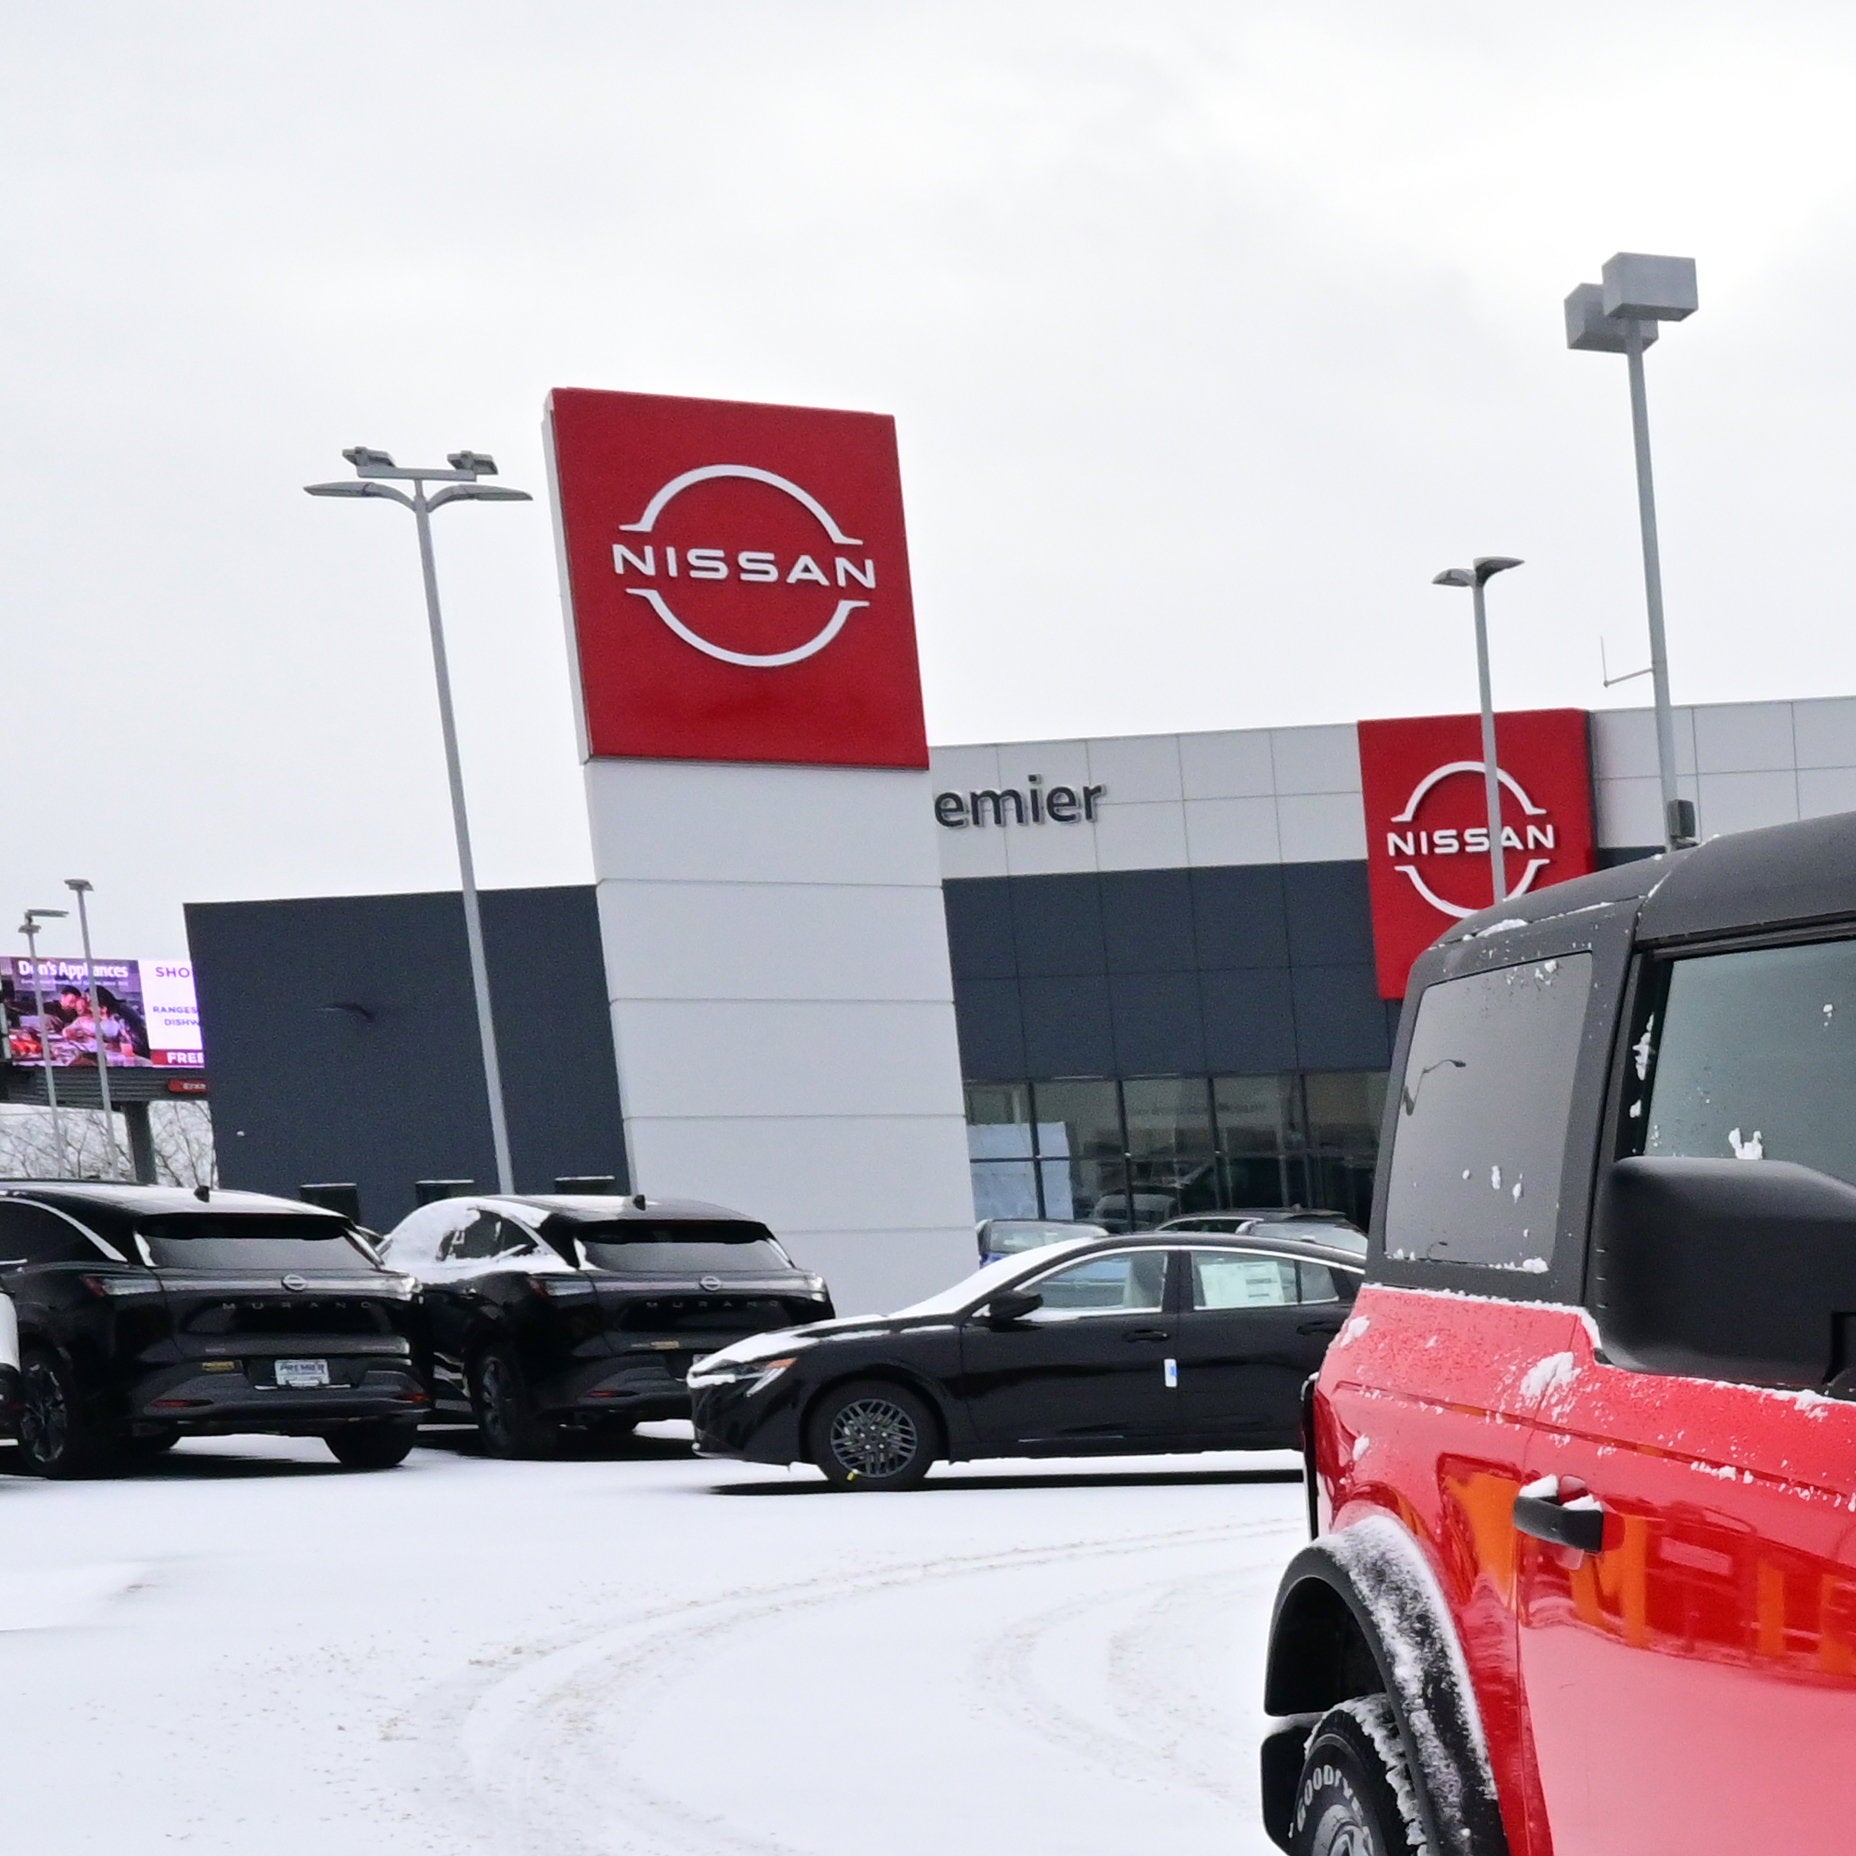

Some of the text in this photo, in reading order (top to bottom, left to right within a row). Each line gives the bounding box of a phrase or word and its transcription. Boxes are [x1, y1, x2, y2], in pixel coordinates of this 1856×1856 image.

[612, 544, 876, 589] NISSAN
[1387, 824, 1555, 856] NISSAN
[59, 962, 129, 979] Applances
[222, 1302, 371, 1310] MURANO
